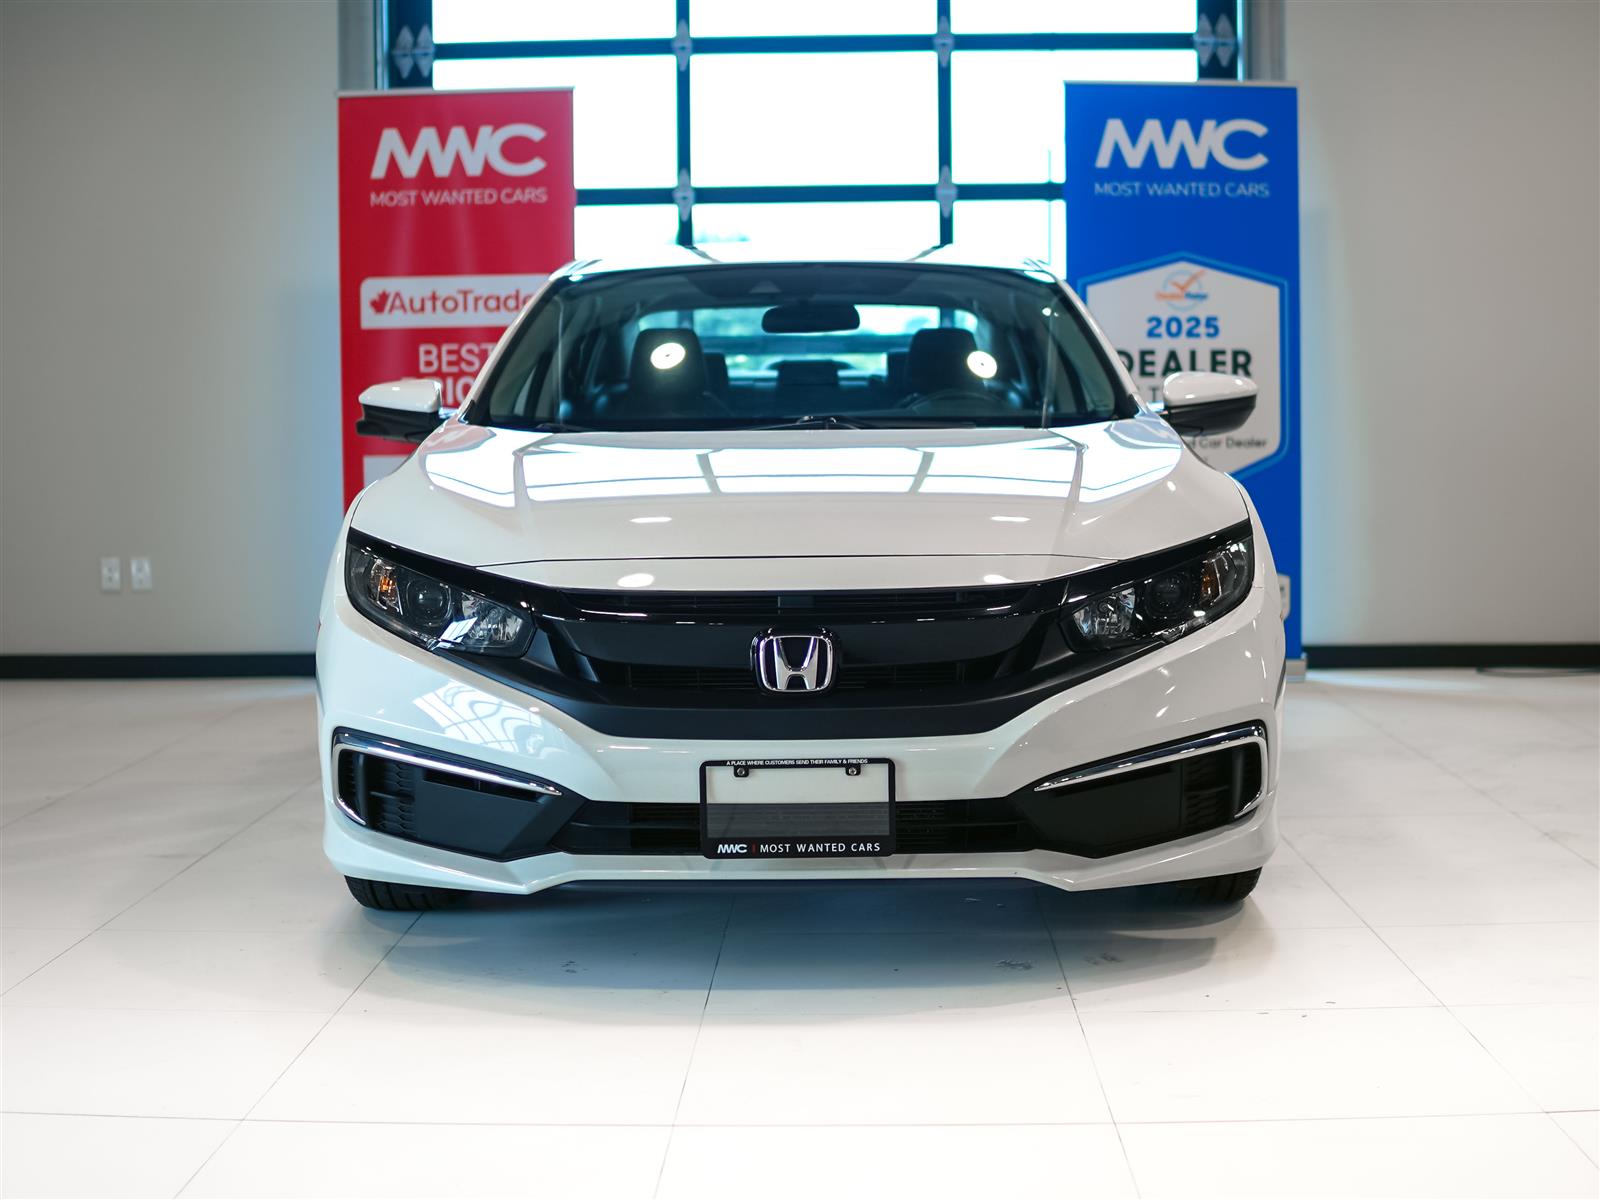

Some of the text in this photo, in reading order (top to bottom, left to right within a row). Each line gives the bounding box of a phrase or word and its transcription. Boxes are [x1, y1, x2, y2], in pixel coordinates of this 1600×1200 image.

[370, 123, 547, 179] MWC
[1095, 118, 1269, 171] MWC
[370, 187, 548, 207] MOST WANTED CARS
[1094, 182, 1270, 198] MOST WANTED CARS
[1146, 316, 1220, 338] 2025
[717, 843, 881, 854] MWC MOST WANTED CARS
